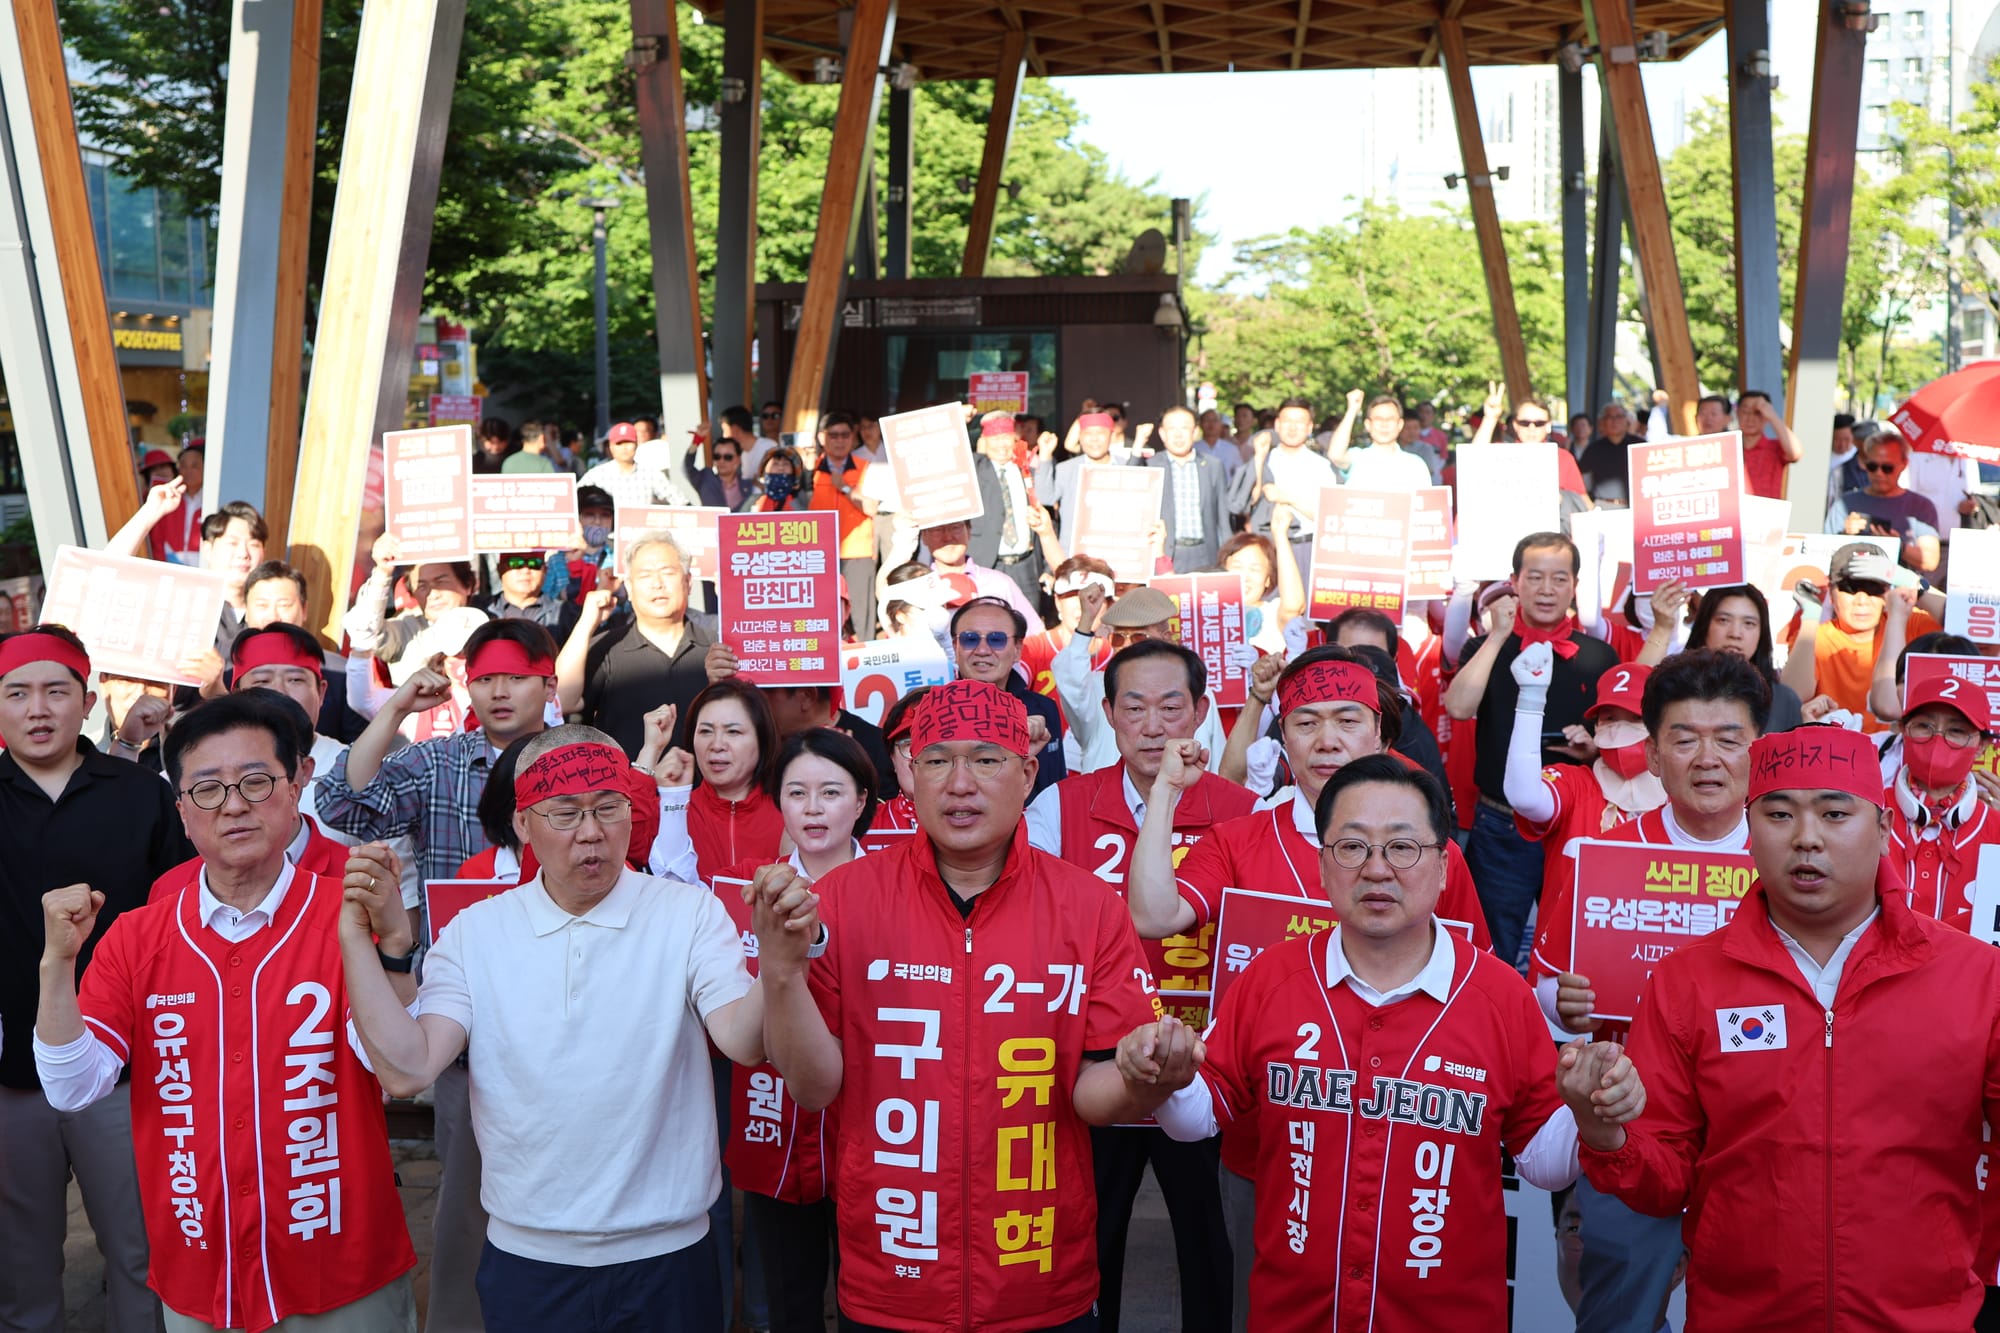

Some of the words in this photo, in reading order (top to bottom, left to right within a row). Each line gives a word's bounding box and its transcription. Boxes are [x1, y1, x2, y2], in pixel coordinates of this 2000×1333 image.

[1656, 496, 1717, 520] 망친다!
[737, 522, 775, 546] 쓰리
[780, 521, 818, 545] 정이
[730, 550, 826, 576] 유성온천을
[746, 581, 812, 605] 망친다!
[731, 620, 777, 634] 시끄러운
[780, 620, 792, 632] 놈
[794, 619, 829, 633] 정청래
[1200, 591, 1220, 643] 계룡시로
[743, 640, 766, 653] 멈춘
[769, 639, 780, 652] 놈
[783, 638, 818, 653] 허태정
[738, 658, 773, 672] 빼앗긴
[775, 658, 787, 671] 놈
[864, 653, 901, 669] 국민의힘
[1612, 670, 1631, 692] 2
[1939, 678, 1960, 699] 2
[919, 683, 1018, 720] 대전시민
[1755, 742, 1856, 780] 사수하자!
[1092, 833, 1126, 883] 2
[1645, 861, 1699, 895] 쓰리
[1584, 896, 1717, 937] 유성온천을
[894, 962, 952, 984] 국민의힘
[157, 991, 196, 1006] 국민의힘
[983, 963, 1087, 1015] 2-가
[1294, 1022, 1322, 1061] 2
[1444, 1060, 1487, 1082] 국민의힘
[1267, 1062, 1357, 1114] DAE
[1360, 1075, 1487, 1136] JEON
[153, 1012, 204, 1240] 유성구청장
[874, 1007, 943, 1261] 구의원
[994, 1037, 1057, 1274] 유대혁
[1287, 1120, 1316, 1254] 대전시장
[1405, 1141, 1456, 1279] 이장우
[894, 1264, 921, 1279] 후보
